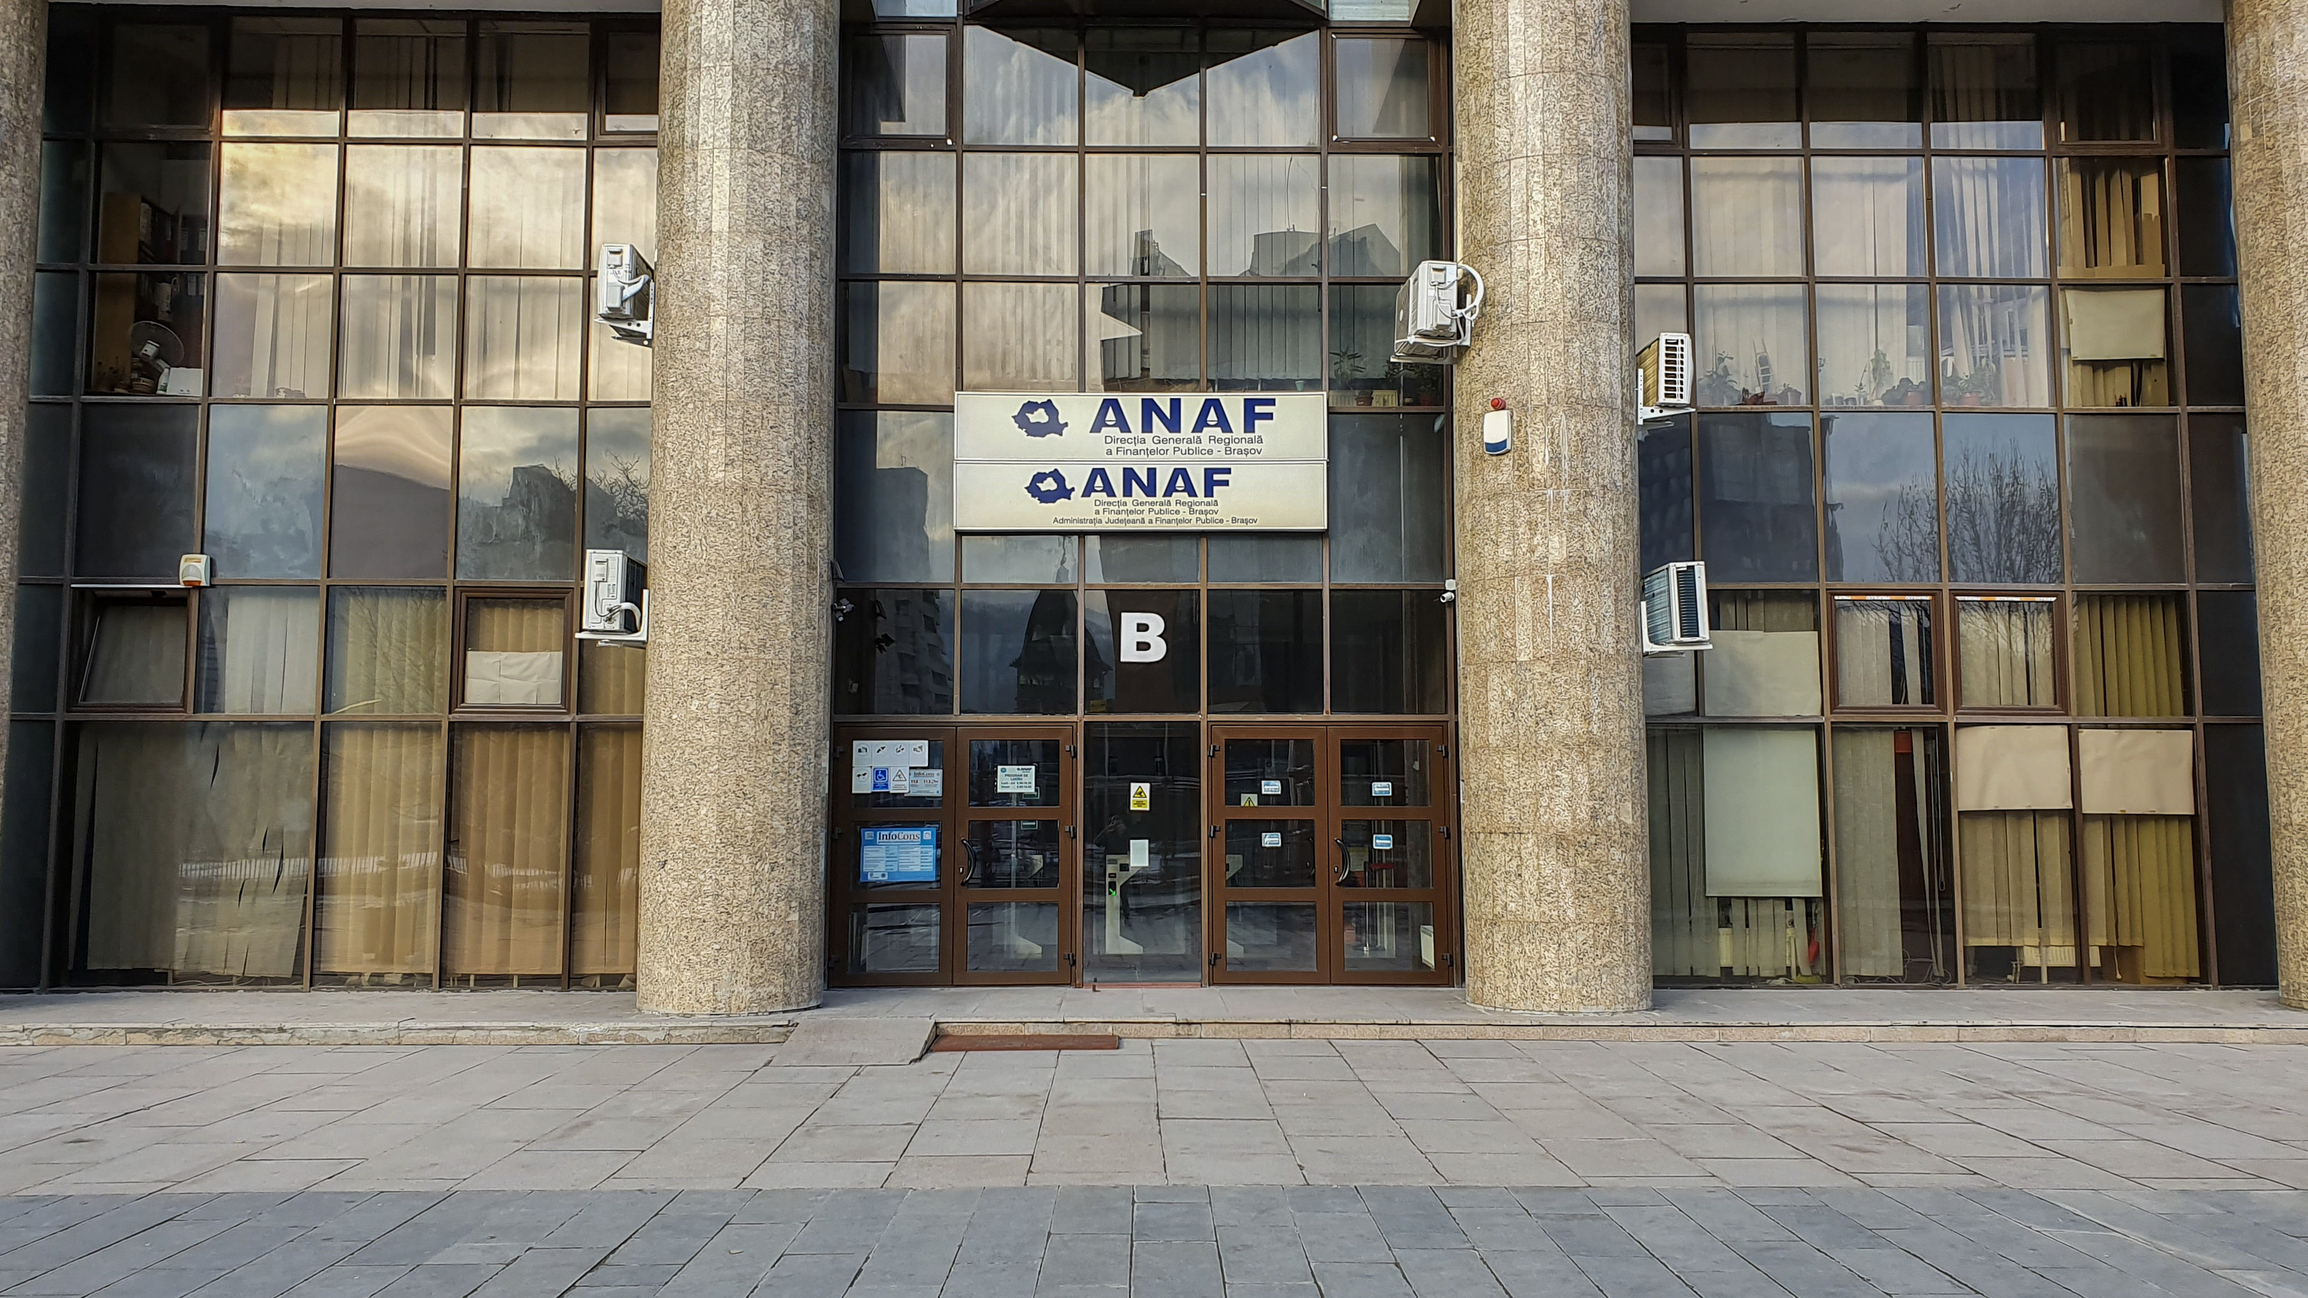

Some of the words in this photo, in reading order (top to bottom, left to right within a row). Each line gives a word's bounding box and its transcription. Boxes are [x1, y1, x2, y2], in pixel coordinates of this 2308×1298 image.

[1089, 397, 1277, 434] ANAF
[1104, 435, 1147, 446] Direcția
[1151, 435, 1202, 445] Generală
[1208, 435, 1264, 447] Regională
[1106, 448, 1112, 456] a
[1116, 447, 1171, 458] Finanțelor
[1173, 446, 1214, 456] Publice
[1224, 446, 1263, 457] Brașov
[1081, 467, 1231, 498] ANAF
[1094, 499, 1128, 508] Direcția
[1131, 499, 1171, 507] Generală
[1175, 499, 1218, 508] Regională
[1148, 507, 1181, 515] Publice
[1188, 507, 1219, 518] Brașov
[1195, 517, 1224, 525] Publice
[1120, 612, 1167, 663] B
[878, 831, 920, 840] InfoCons
